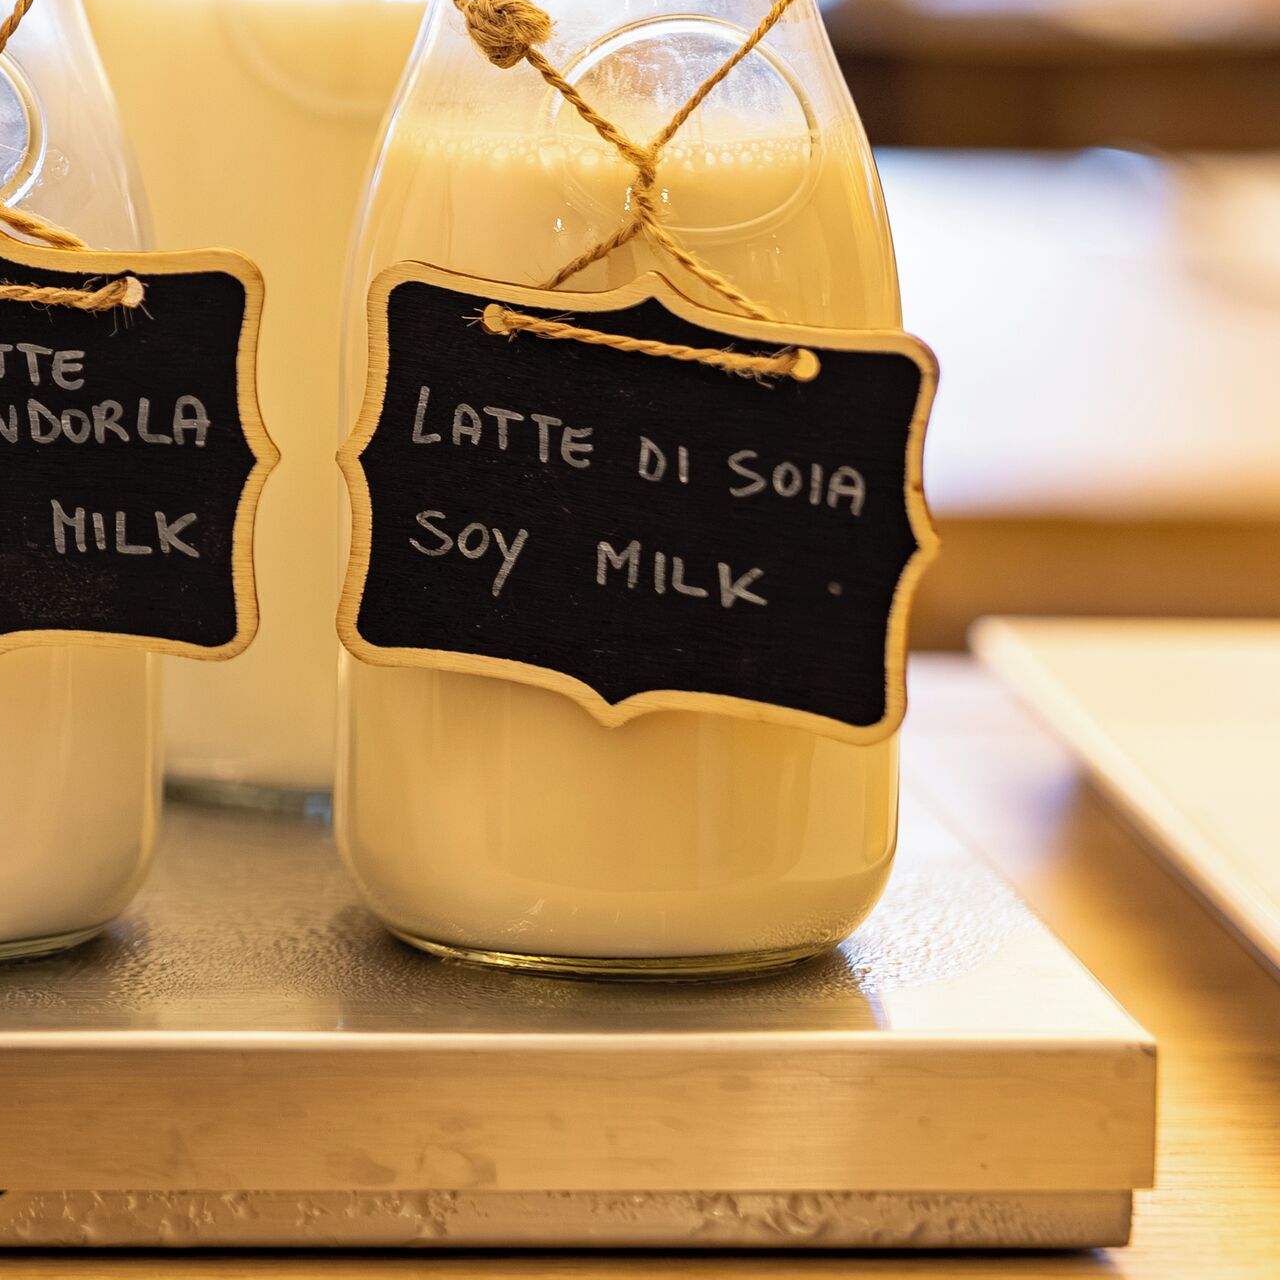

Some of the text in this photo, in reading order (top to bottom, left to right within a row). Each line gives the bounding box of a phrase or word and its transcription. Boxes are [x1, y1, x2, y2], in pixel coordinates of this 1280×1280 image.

[411, 384, 866, 518] LATTE DI SOIA
[50, 498, 200, 559] MILK
[408, 509, 769, 609] SOY MILK
